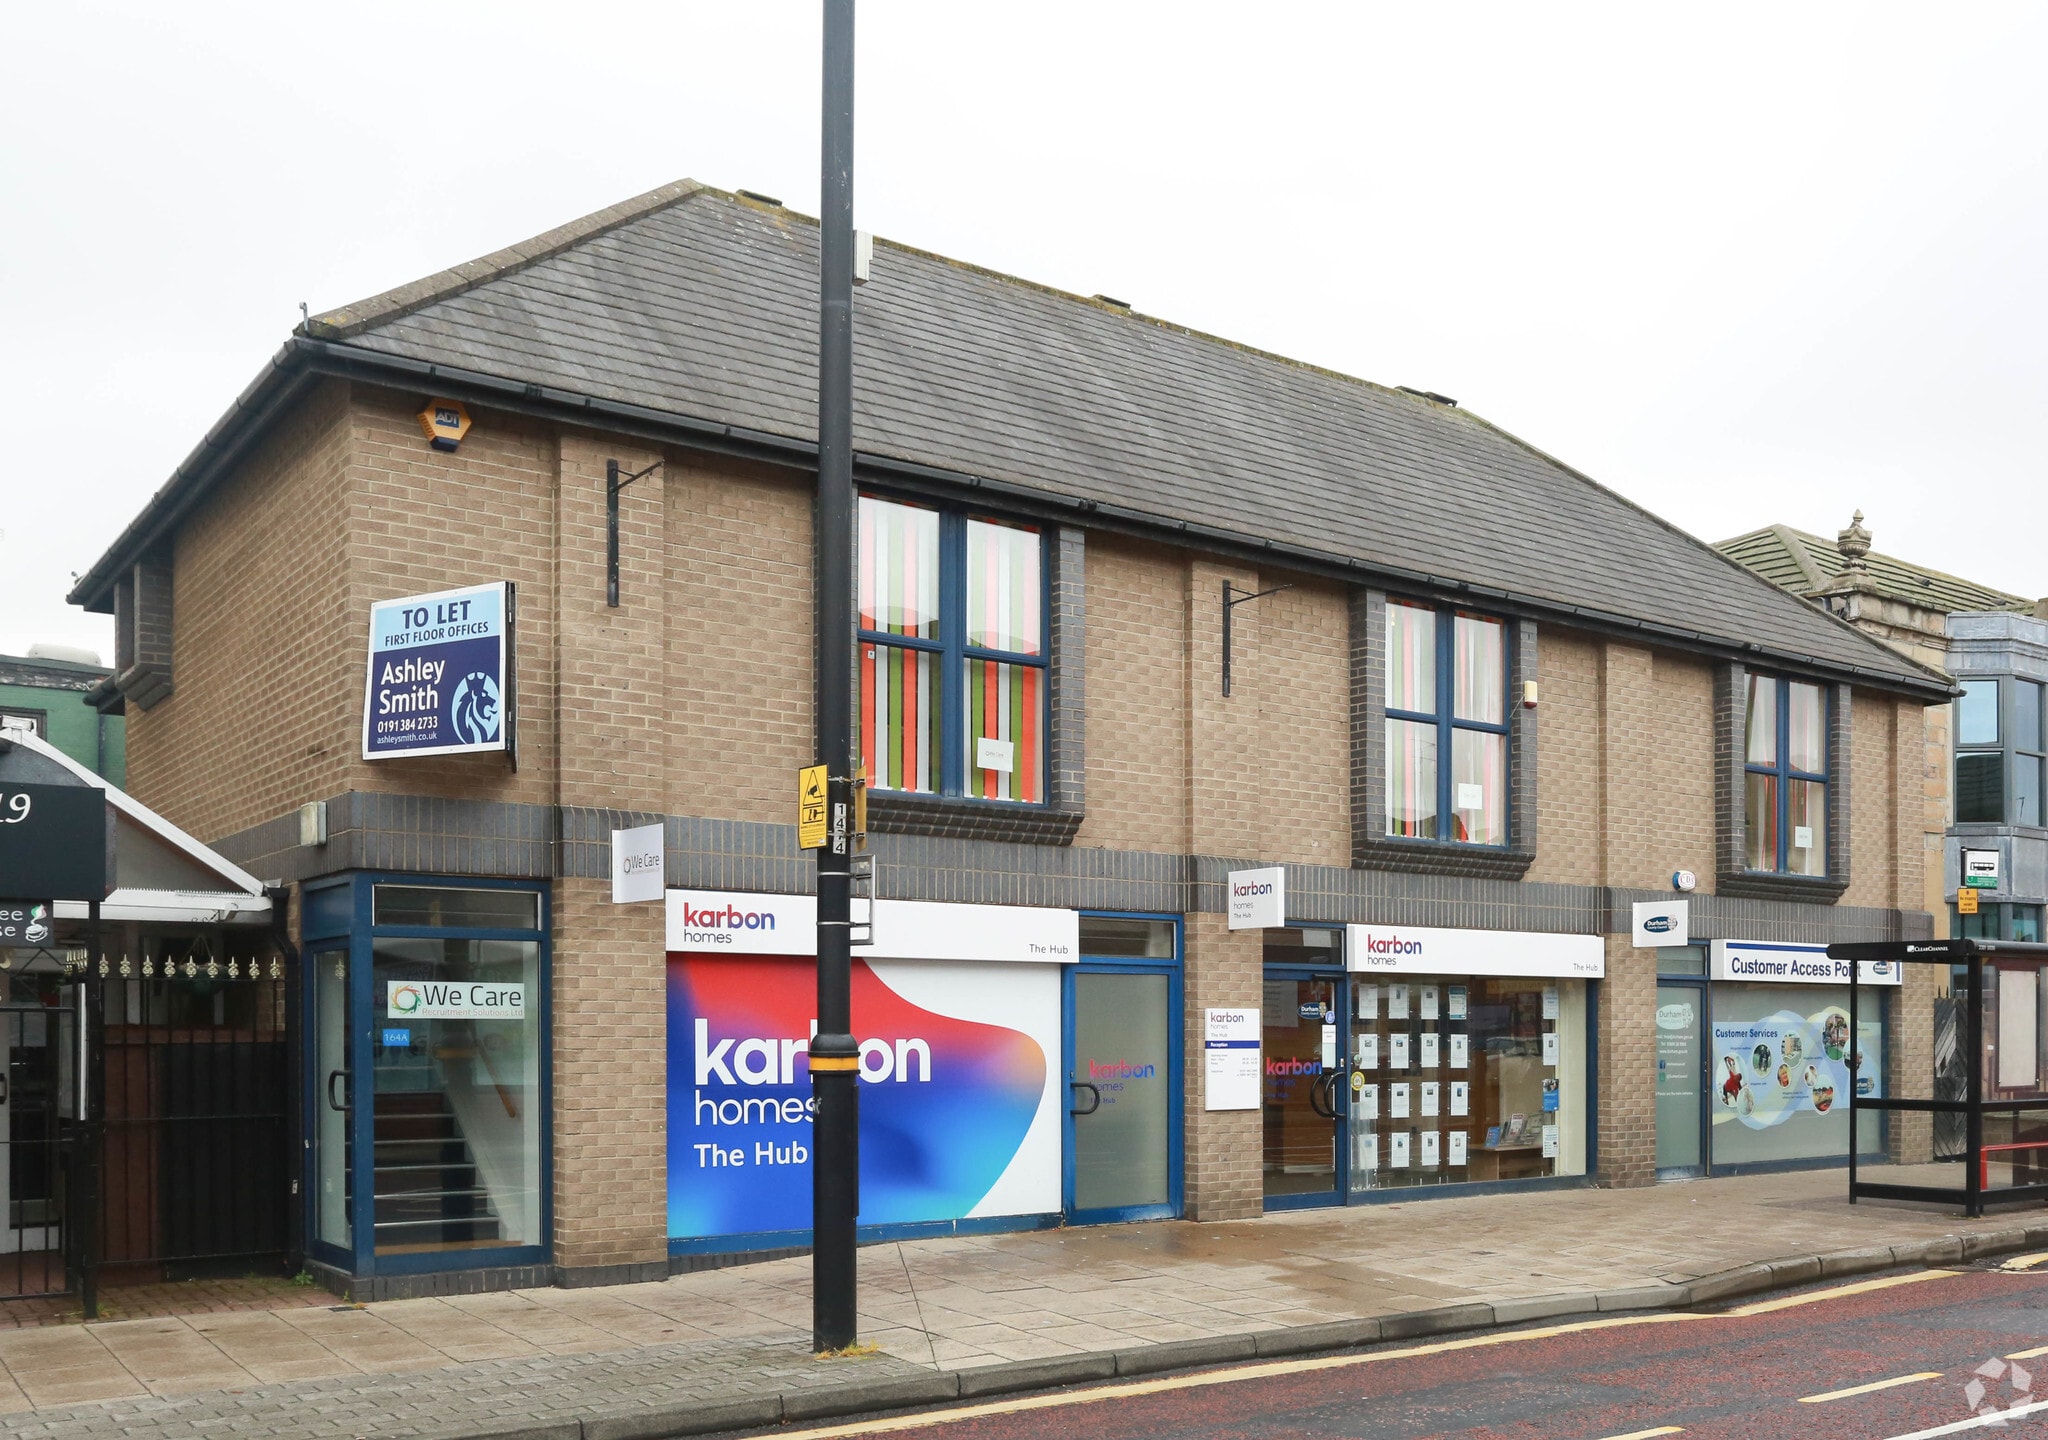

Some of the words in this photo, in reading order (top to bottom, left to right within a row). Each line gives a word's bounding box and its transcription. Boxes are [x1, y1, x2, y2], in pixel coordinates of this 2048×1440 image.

[436, 411, 458, 425] ADT
[402, 607, 429, 629] TO
[437, 600, 471, 625] LET
[385, 632, 411, 647] FIRST
[413, 628, 444, 643] FLOOR
[448, 621, 489, 638] OFFICES
[380, 657, 446, 686] Ashley
[378, 684, 439, 715] Smith
[377, 720, 399, 733] 0191
[400, 718, 416, 731] 384
[417, 716, 438, 730] 2733
[377, 731, 438, 745] ashleysmith.co.uk
[0, 792, 31, 823] 9
[631, 854, 642, 869] We
[644, 853, 660, 867] Care
[1233, 880, 1273, 897] karbon
[1233, 901, 1254, 910] homes
[683, 902, 775, 930] karbon
[683, 930, 733, 944] homes
[1367, 934, 1422, 955] karbon
[1029, 944, 1046, 954] The
[1049, 944, 1069, 955] Hub
[1367, 955, 1397, 966] homes
[1573, 963, 1584, 971] The
[1585, 964, 1598, 972] Hub
[1731, 957, 1788, 975] Customer
[1790, 959, 1832, 977] Access
[1835, 961, 1861, 978] Poit
[423, 985, 462, 1007] We
[470, 985, 522, 1007] Care
[422, 1008, 472, 1017] Recruitment
[473, 1008, 509, 1017] Solutions
[511, 1008, 523, 1017] Ltd
[1210, 1011, 1244, 1023] karbon
[384, 1033, 408, 1042] 164A
[1715, 1028, 1749, 1038] Customer
[1749, 1029, 1778, 1038] Services
[694, 1018, 932, 1085] karon
[1089, 1058, 1155, 1079] karbon
[1266, 1056, 1322, 1075] karbon
[694, 1143, 745, 1168] The
[754, 1141, 808, 1166] Hub
